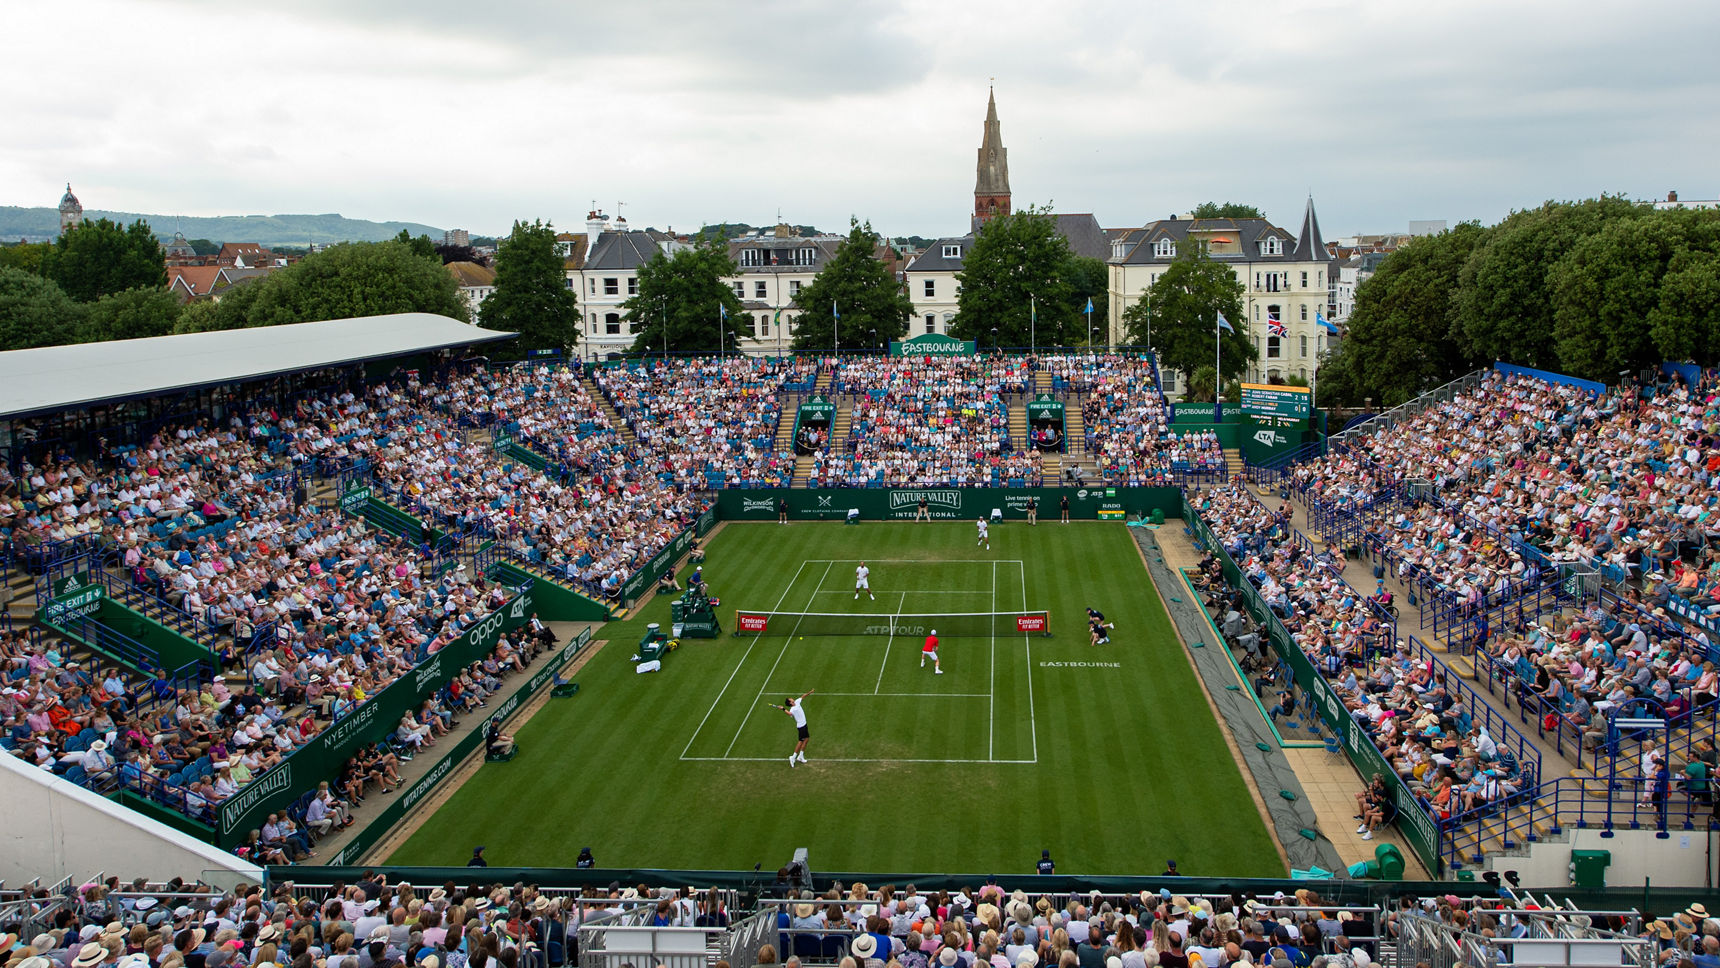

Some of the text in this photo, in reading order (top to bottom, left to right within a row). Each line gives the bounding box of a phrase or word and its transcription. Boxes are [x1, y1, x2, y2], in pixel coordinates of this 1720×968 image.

[901, 342, 965, 355] EASTBOURNE
[1175, 408, 1214, 416] EASTBOURNE
[893, 492, 959, 507] NATURE VALLEY
[63, 584, 81, 594] adidas
[67, 595, 84, 608] EXIT
[470, 612, 503, 646] oppo
[863, 625, 890, 635] ATP
[416, 660, 441, 683] WILKINSON
[324, 702, 379, 749] NYETIMBER
[403, 757, 452, 809] WTATENNIS.COM
[225, 766, 289, 828] NATURE VALLEY
[1398, 786, 1435, 852] NATURE VALLEY
